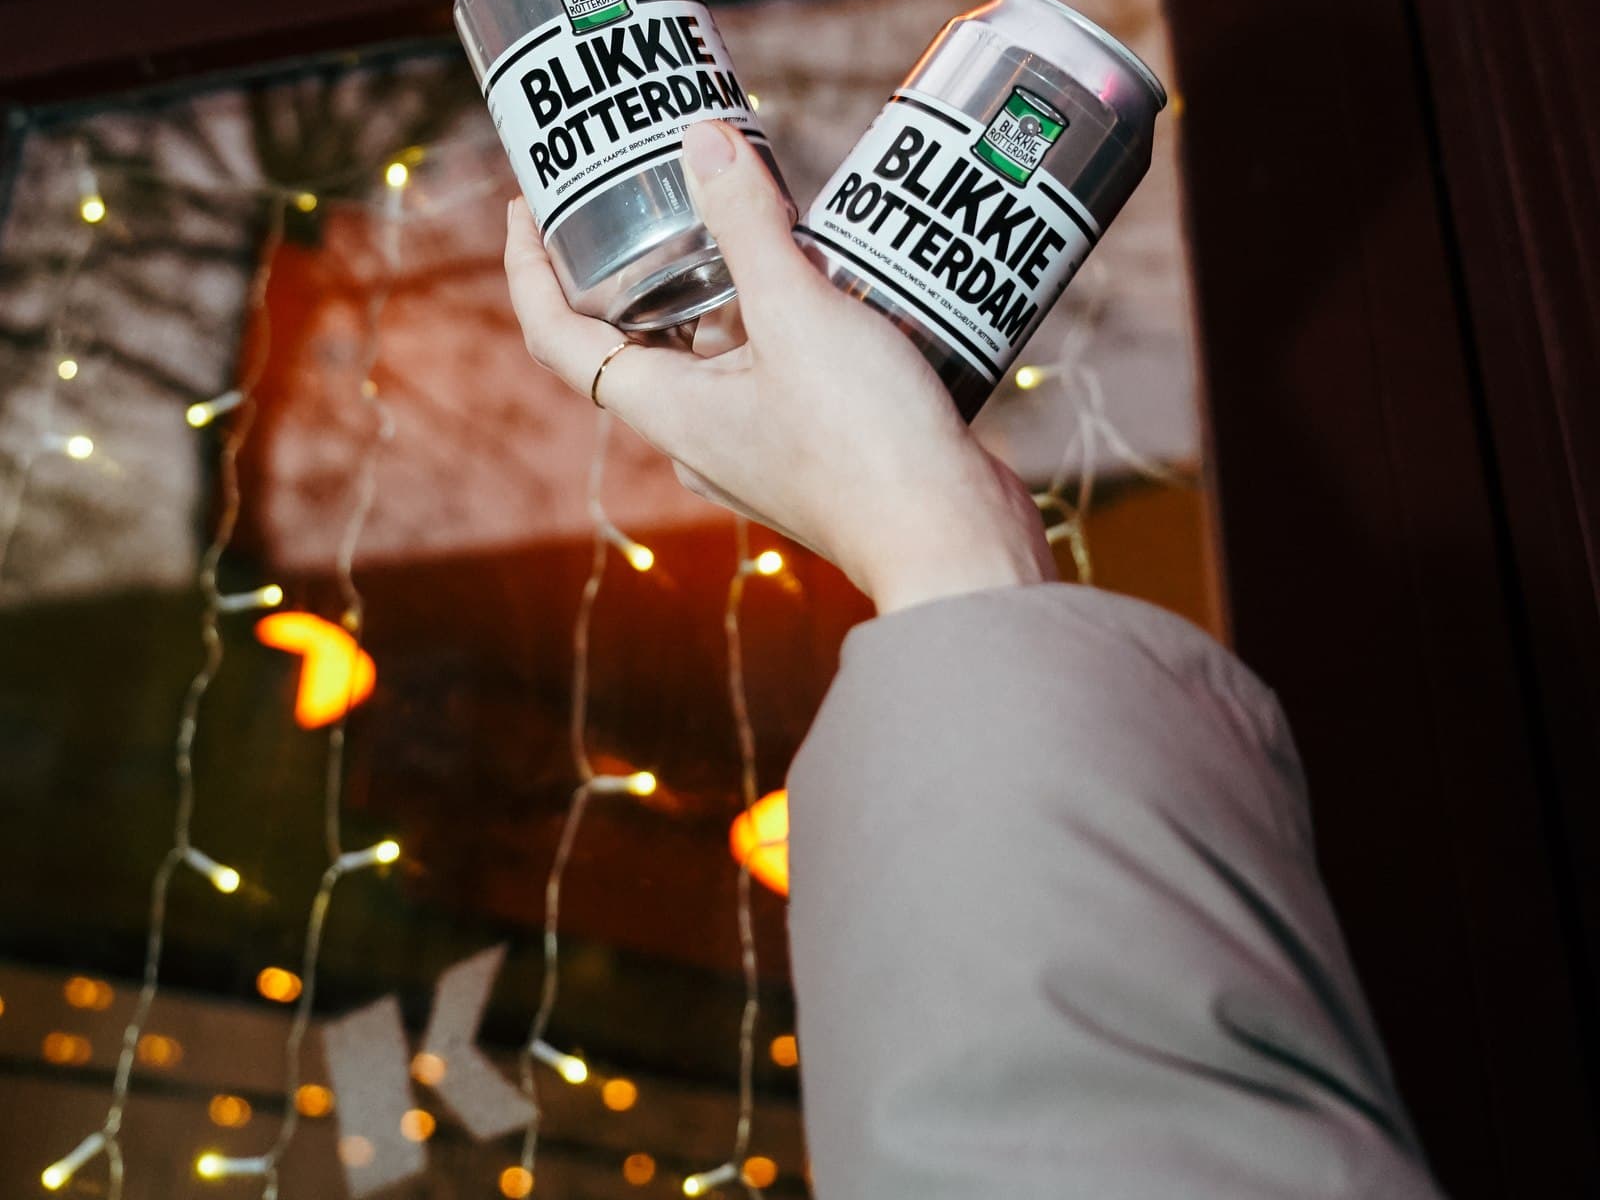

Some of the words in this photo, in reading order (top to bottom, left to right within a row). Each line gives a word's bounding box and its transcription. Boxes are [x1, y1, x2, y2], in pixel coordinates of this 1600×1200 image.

[520, 15, 717, 130] BLIKKIE
[529, 69, 750, 189] ROTTERDAM
[556, 172, 586, 195] GEBROUWEN
[586, 161, 602, 178] DOOR
[603, 147, 628, 168] KAAPSE
[629, 132, 666, 154] BROUWERS
[667, 126, 681, 137] MET
[987, 128, 1037, 167] ROTTERDAM
[999, 120, 1042, 156] BLIKKIE
[872, 125, 1067, 290] BLIKKIE
[825, 171, 1040, 348] ROTTERDAM
[852, 236, 868, 250] DOOR
[869, 245, 892, 266] KAAPSE
[893, 263, 927, 291] BROUWERS
[927, 287, 940, 299] MET
[940, 297, 953, 311] EEN
